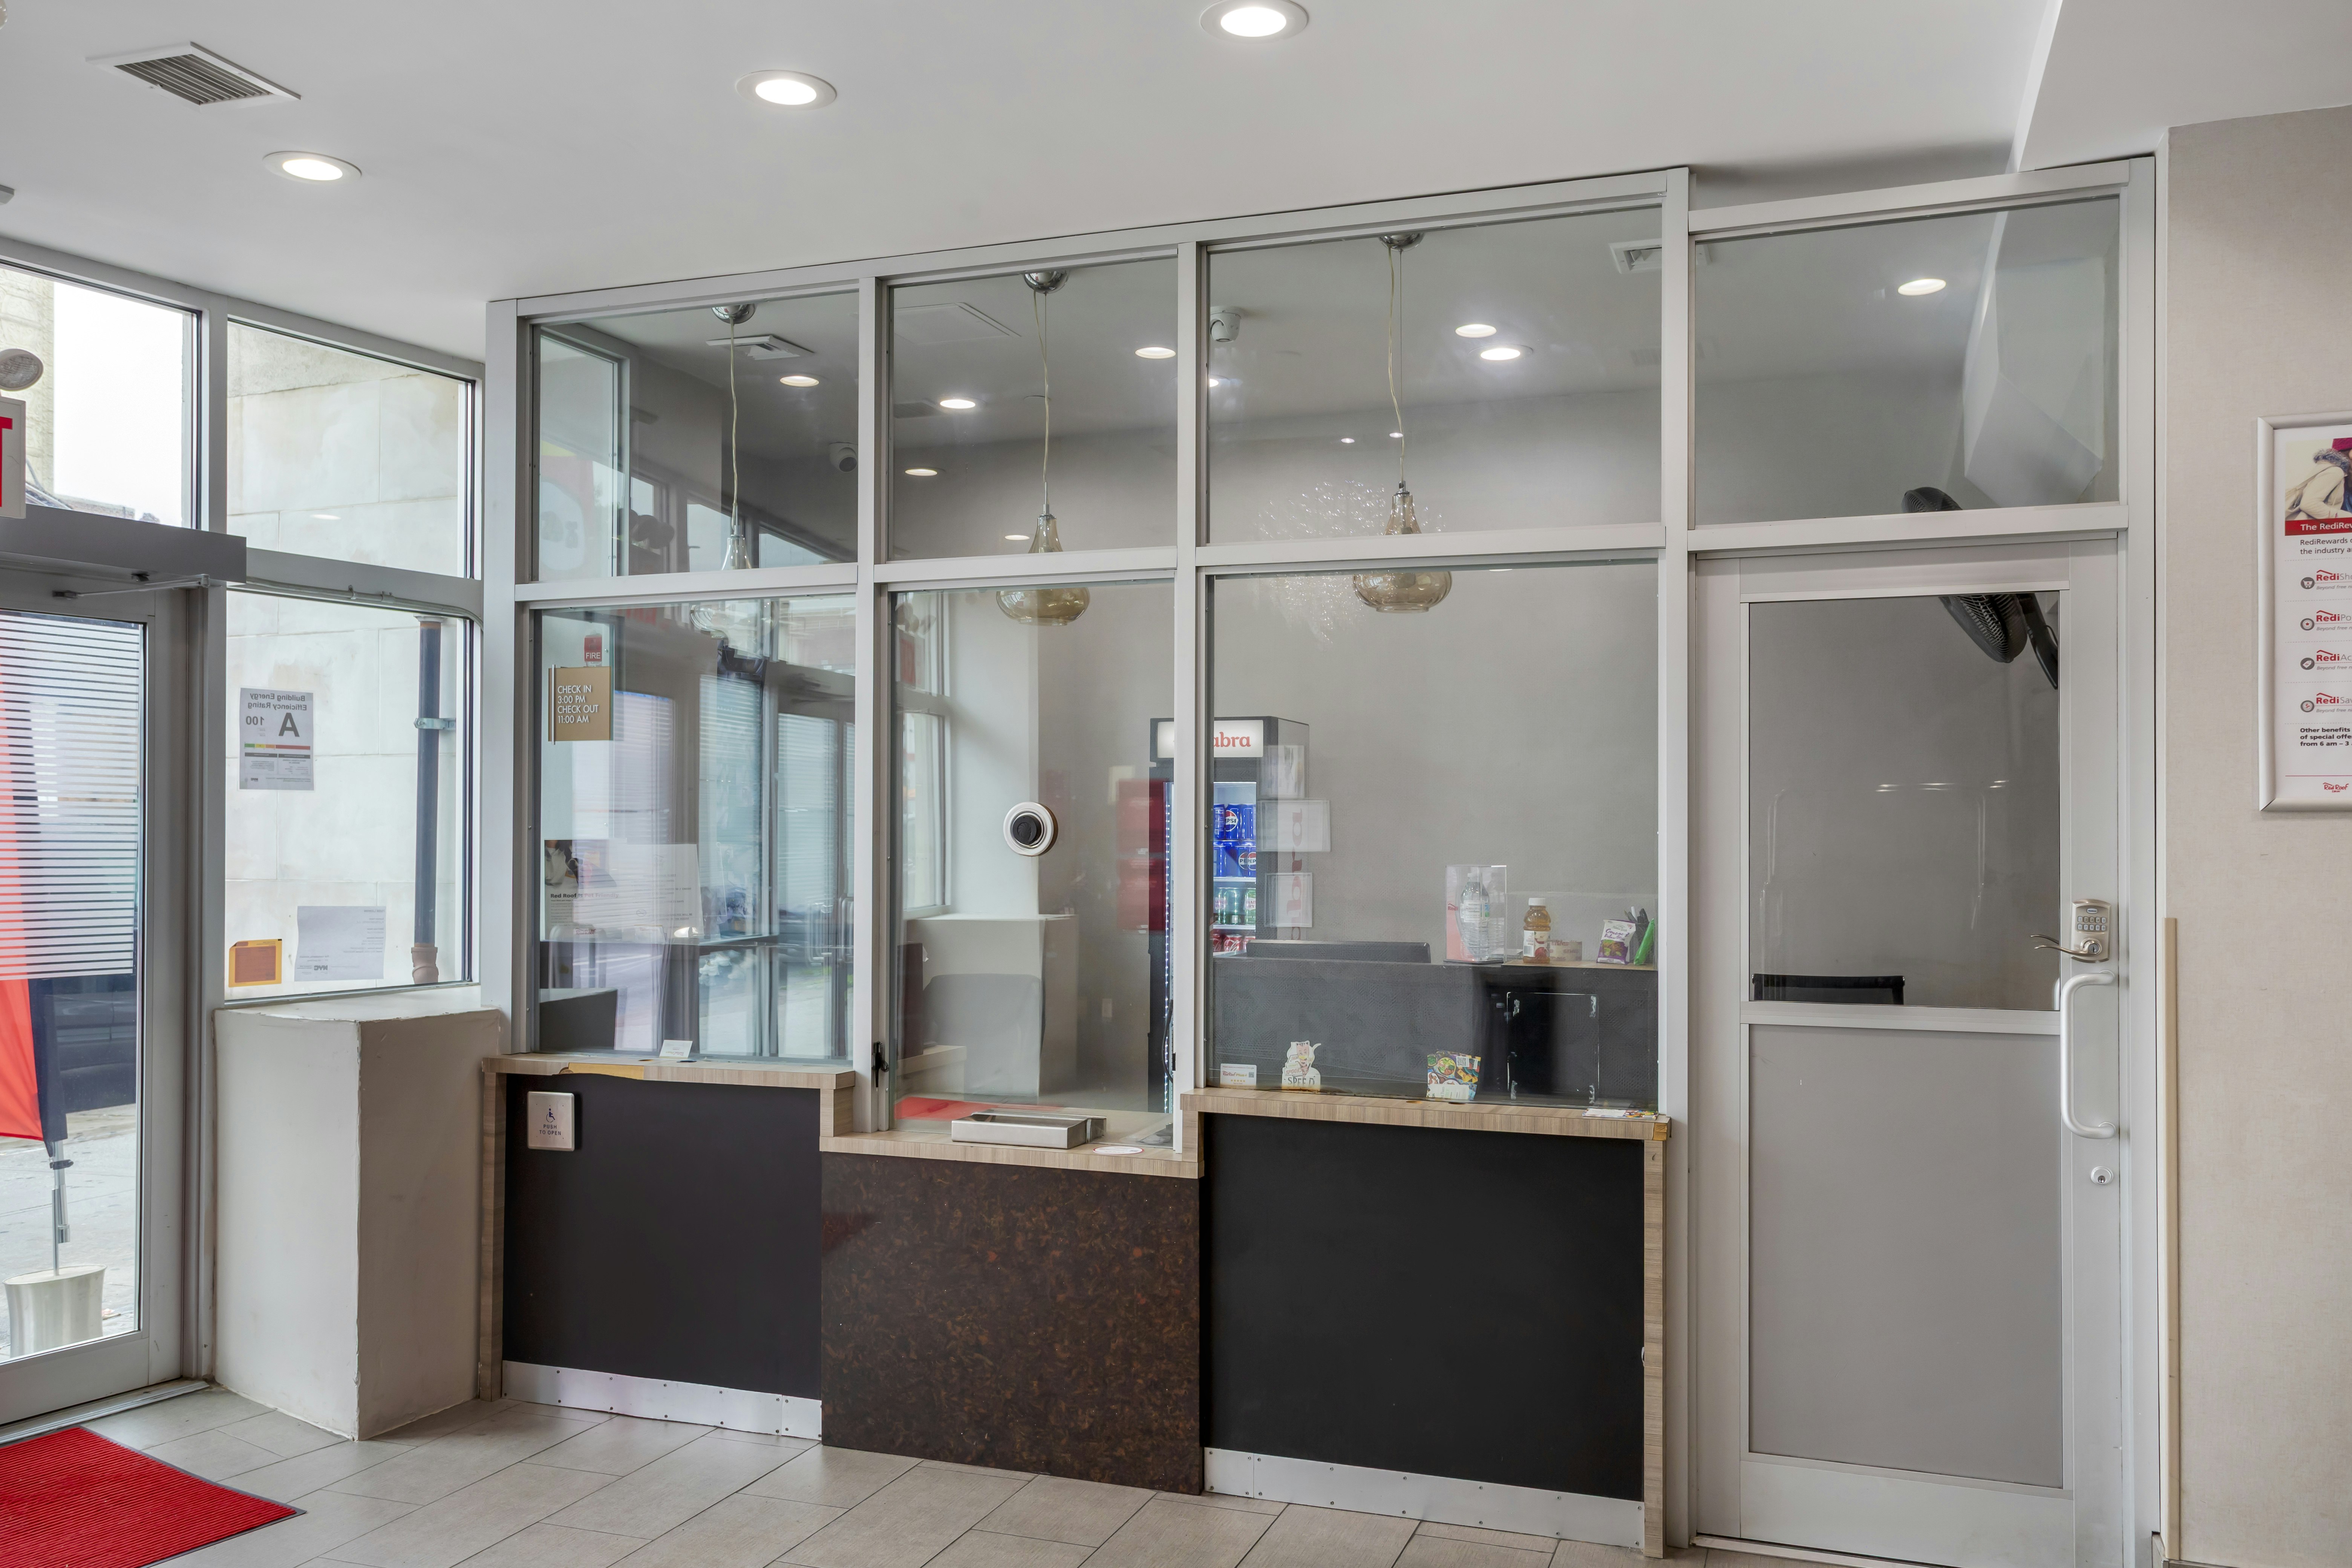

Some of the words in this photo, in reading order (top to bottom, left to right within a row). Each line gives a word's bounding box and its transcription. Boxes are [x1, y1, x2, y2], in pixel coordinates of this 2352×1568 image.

[558, 685, 581, 694] CHECK
[558, 695, 573, 704] 3:00
[558, 705, 581, 714] CHECK
[1213, 732, 1251, 747] abra
